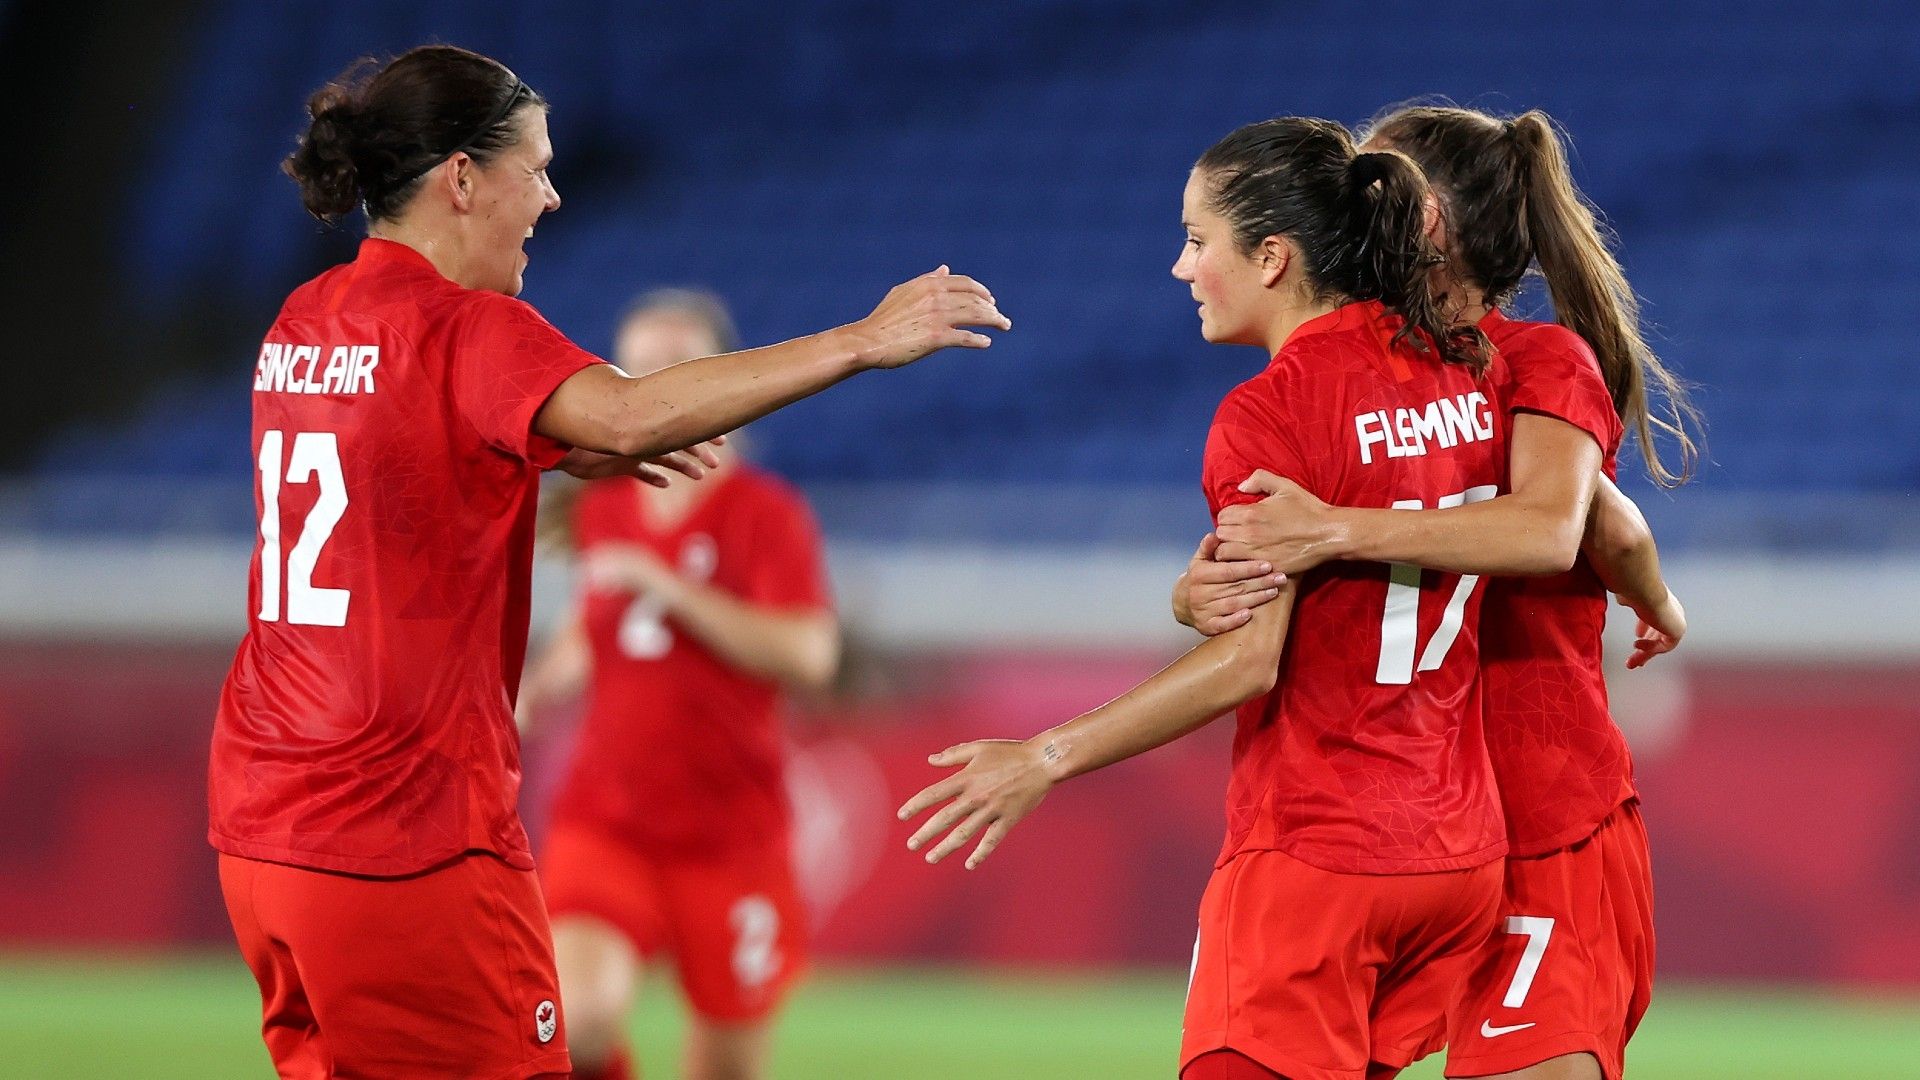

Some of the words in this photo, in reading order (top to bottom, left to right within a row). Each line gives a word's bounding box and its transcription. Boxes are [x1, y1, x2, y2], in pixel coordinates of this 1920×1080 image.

[254, 343, 379, 394] SINCLAIR
[1355, 391, 1493, 464] FLEMNG
[258, 429, 351, 626] 12
[1375, 484, 1498, 684] 17
[1502, 916, 1555, 1008] 7
